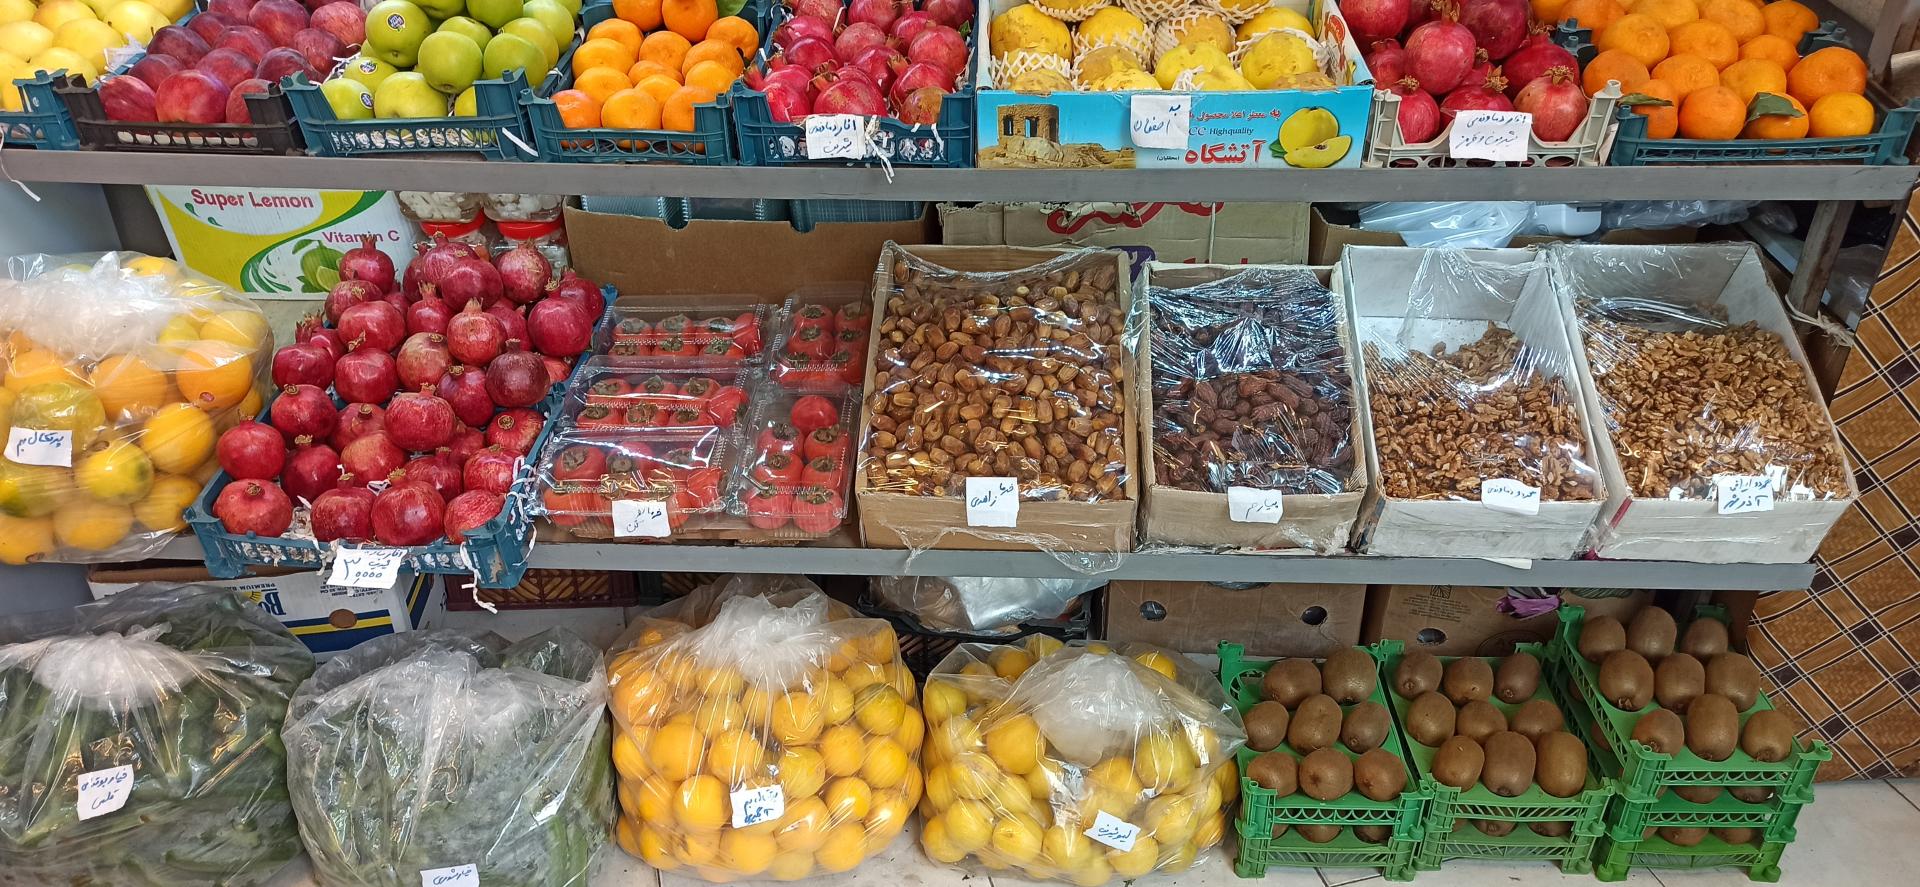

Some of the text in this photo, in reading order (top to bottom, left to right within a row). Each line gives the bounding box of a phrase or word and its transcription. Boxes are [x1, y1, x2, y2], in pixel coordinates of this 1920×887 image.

[835, 118, 857, 136] انار
[1209, 127, 1254, 137] Highquality
[1184, 139, 1267, 165] آتشگاه
[191, 188, 316, 211] Super Lemon
[387, 229, 401, 242] C
[998, 482, 1015, 496] خرما
[970, 490, 998, 508] زاهدی
[239, 582, 276, 591] PREMIUM
